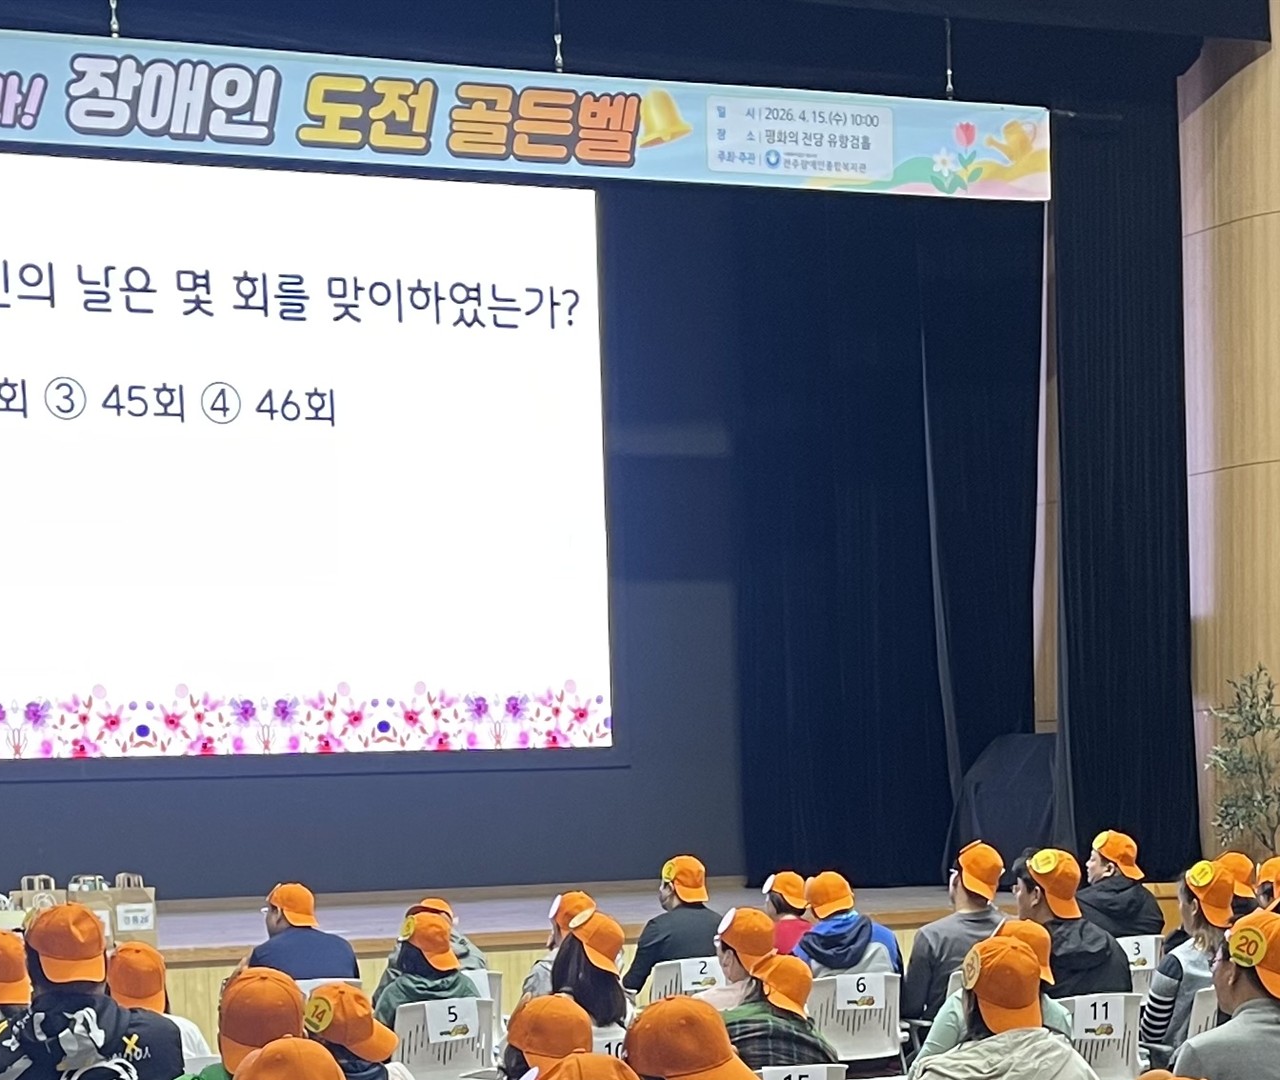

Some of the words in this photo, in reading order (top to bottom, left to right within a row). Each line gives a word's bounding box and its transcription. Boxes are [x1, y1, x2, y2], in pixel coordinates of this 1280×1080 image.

[66, 53, 282, 145] 장애인
[296, 73, 439, 156] 도전
[446, 81, 641, 168] 골든벨
[765, 107, 795, 121] 2026.
[798, 109, 809, 123] 4.
[850, 112, 880, 127] 10:00
[765, 129, 799, 145] 평화의
[801, 131, 825, 147] 전당
[78, 265, 157, 313] 날은
[176, 270, 213, 316] 몇
[233, 271, 309, 321] 회를
[328, 277, 579, 329] 맞이하였는가?
[102, 383, 184, 423] 45회
[256, 388, 334, 426] 46회
[1133, 941, 1141, 956] 3
[1236, 935, 1259, 957] 20
[699, 960, 708, 975] 2
[856, 977, 867, 993] 6
[311, 1004, 327, 1023] 14
[447, 1005, 458, 1023] 5
[1090, 1001, 1109, 1021] 11
